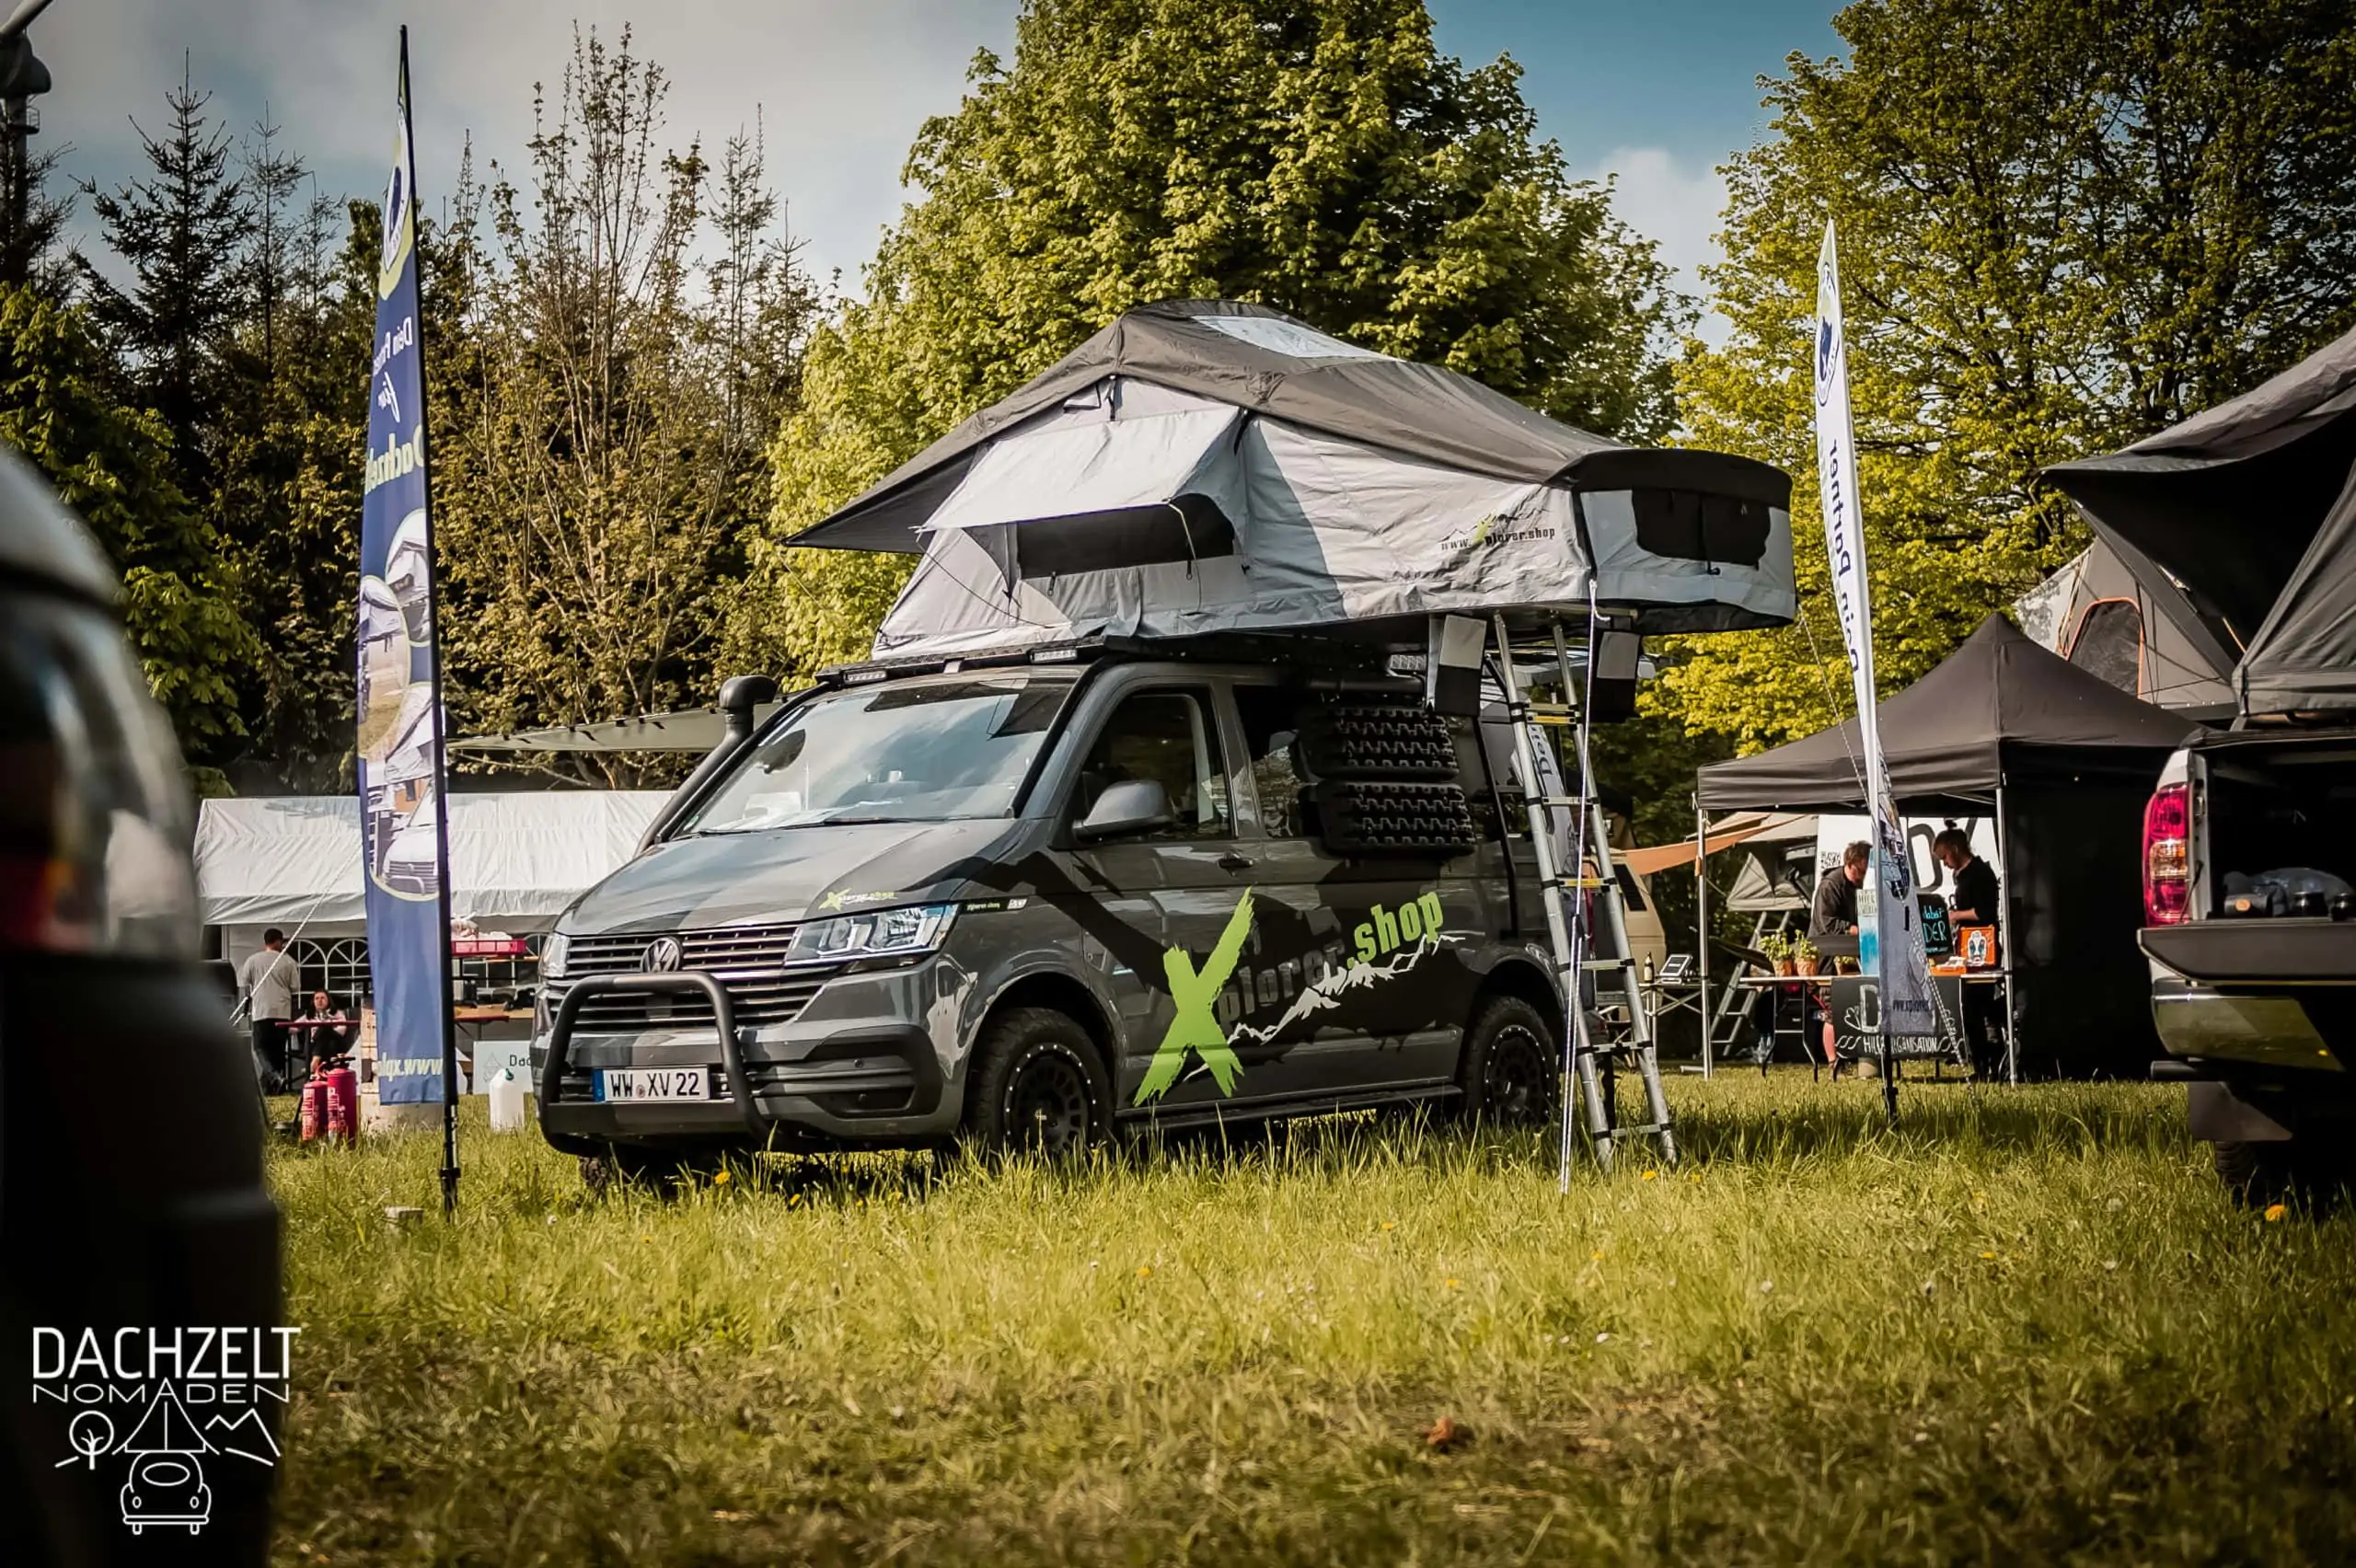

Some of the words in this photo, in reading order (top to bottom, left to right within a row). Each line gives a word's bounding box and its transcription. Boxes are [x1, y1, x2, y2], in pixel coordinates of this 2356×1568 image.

[610, 1073, 633, 1097] WW
[647, 1073, 670, 1097] XV
[676, 1072, 700, 1096] 22
